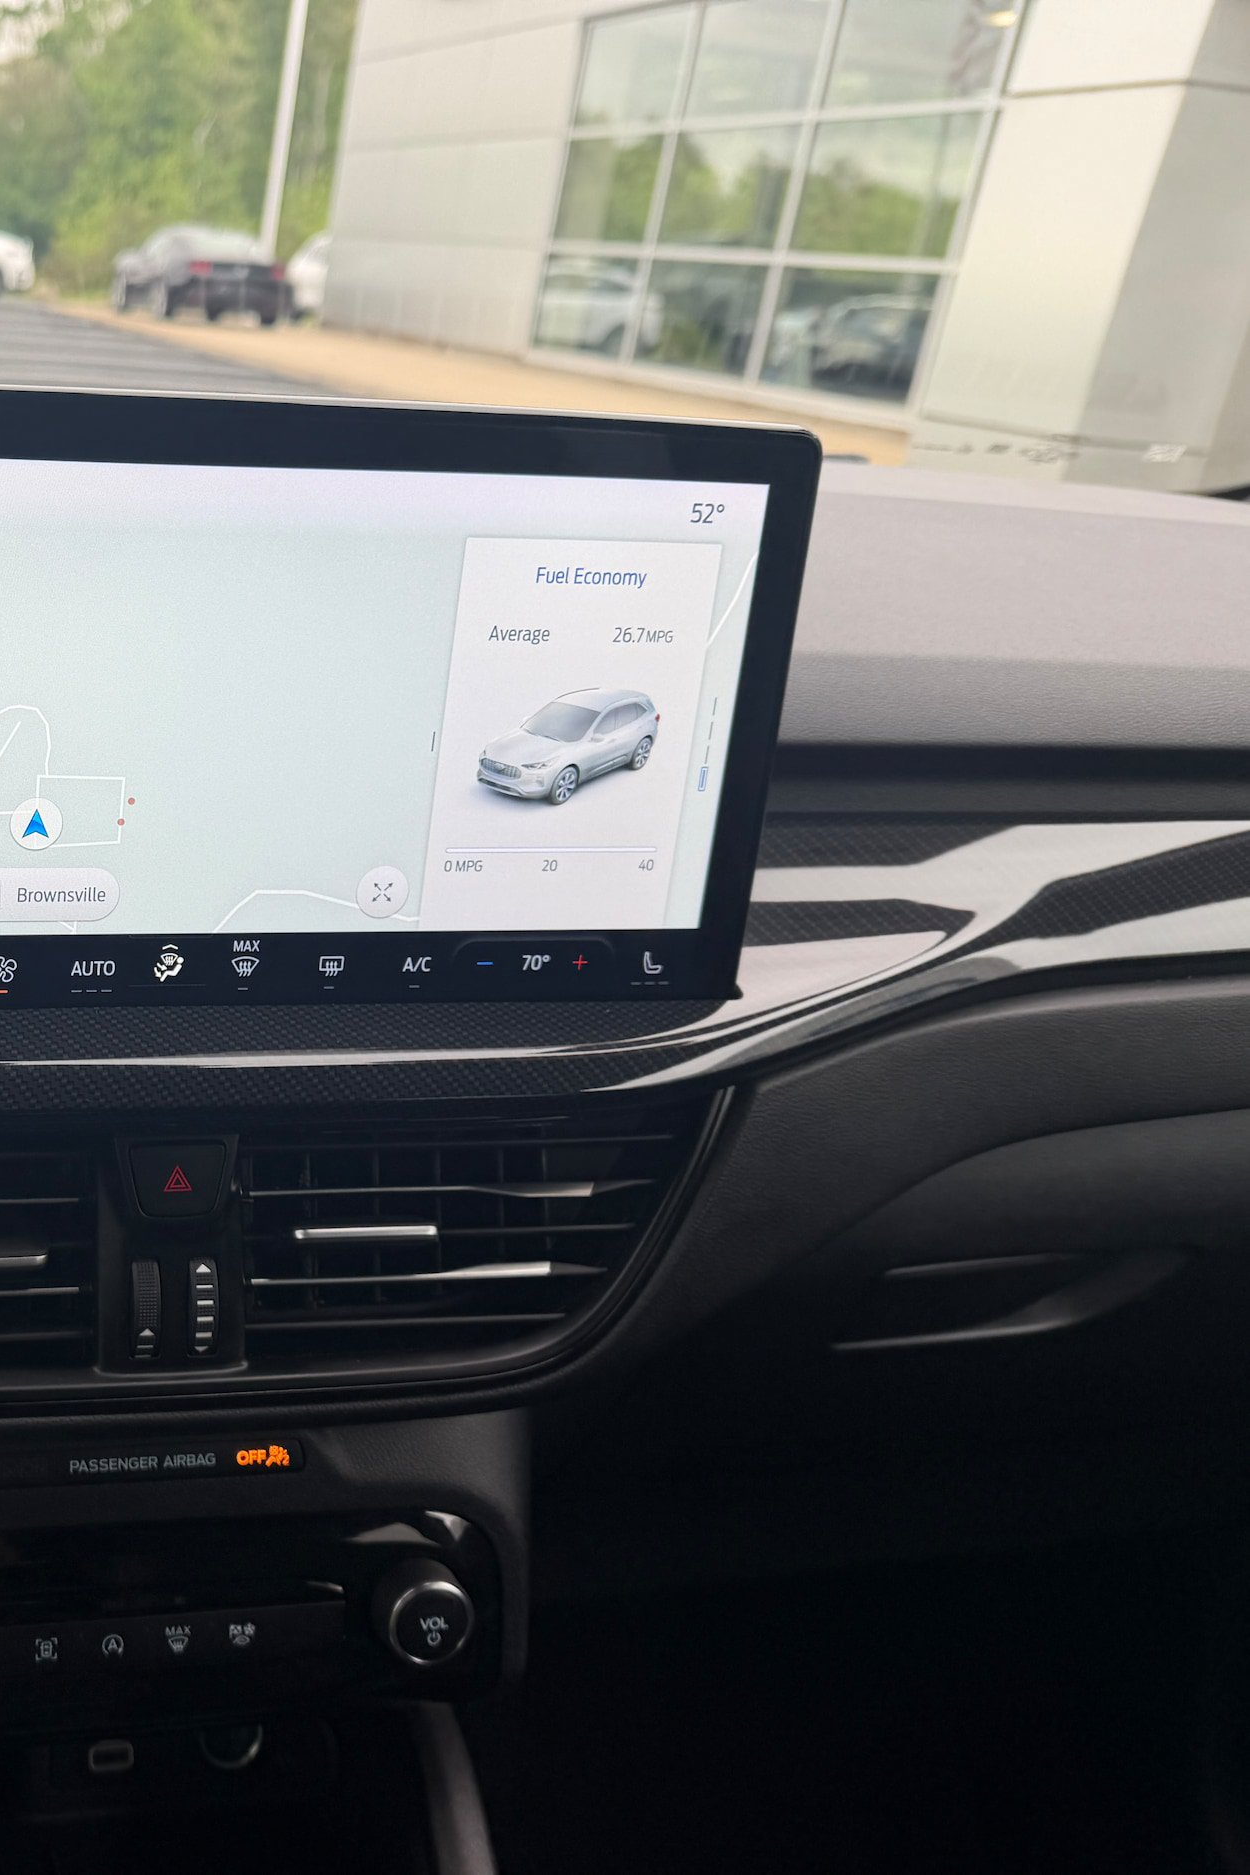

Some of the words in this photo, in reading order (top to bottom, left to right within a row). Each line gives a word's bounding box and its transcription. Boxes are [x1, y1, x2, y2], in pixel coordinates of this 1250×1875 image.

[689, 503, 726, 525] 52°
[535, 567, 570, 586] Fuel
[573, 568, 647, 589] Economy
[488, 624, 551, 646] Average
[444, 860, 453, 873] 0
[455, 860, 483, 873] MPG
[541, 860, 558, 873] 20
[638, 859, 654, 872] 40
[16, 885, 106, 903] Brownsville
[232, 940, 260, 953] MAX
[71, 960, 116, 977] AUTO
[403, 956, 431, 974] A/C
[521, 954, 551, 972] 70°
[69, 1455, 159, 1475] PASSENGER
[163, 1453, 217, 1468] AIRBAG
[236, 1449, 267, 1466] OFF
[165, 1625, 191, 1636] MAX
[419, 1616, 450, 1631] VOL
